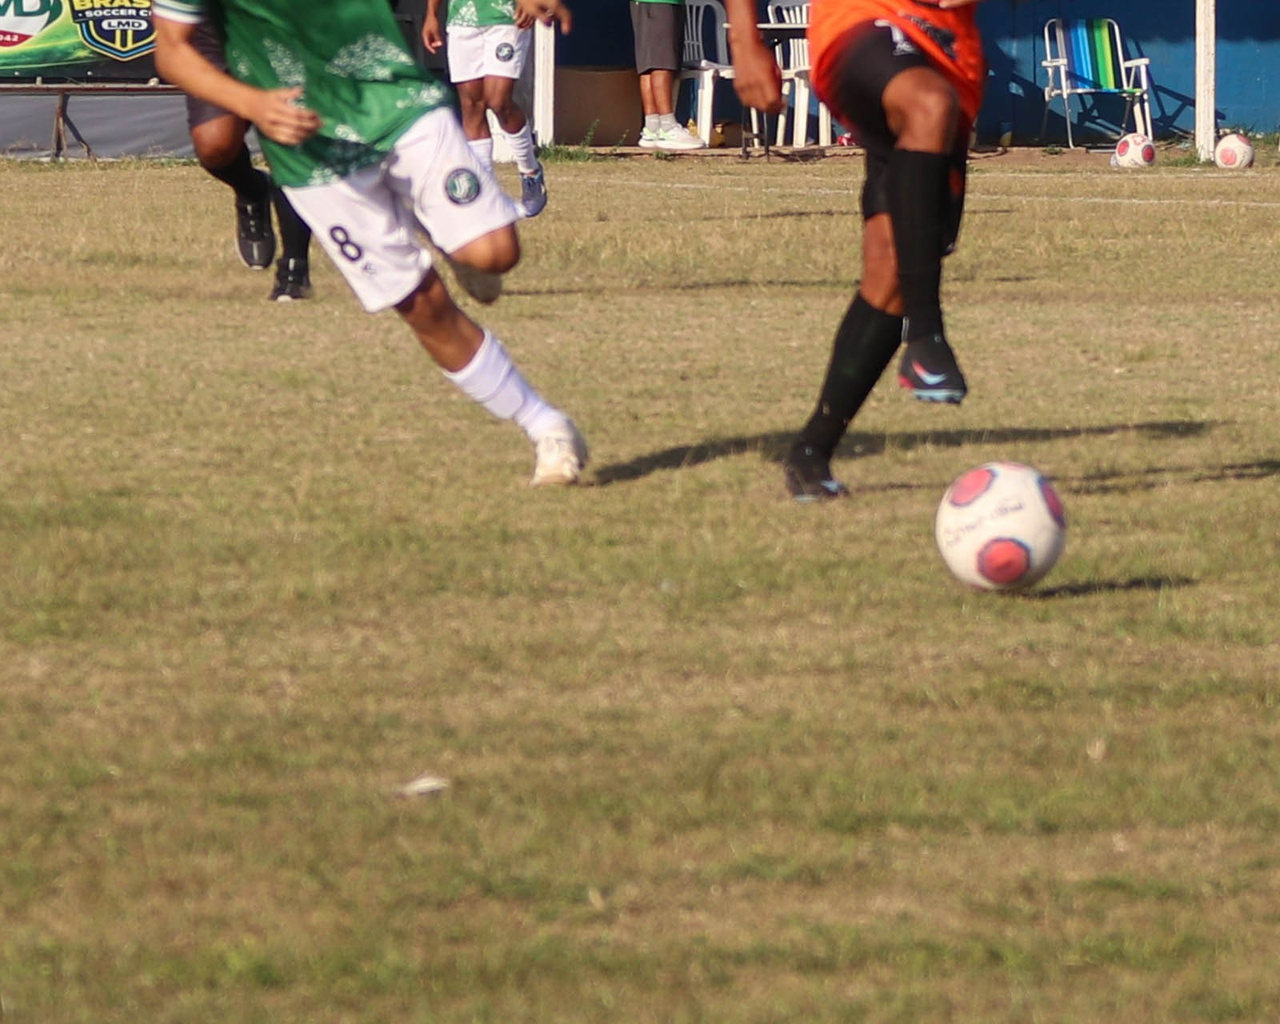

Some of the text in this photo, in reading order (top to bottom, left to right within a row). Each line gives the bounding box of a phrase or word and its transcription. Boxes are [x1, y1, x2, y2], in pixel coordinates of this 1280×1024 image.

[85, 8, 137, 18] SOCCER
[107, 21, 142, 29] LMD
[330, 226, 362, 261] 8
